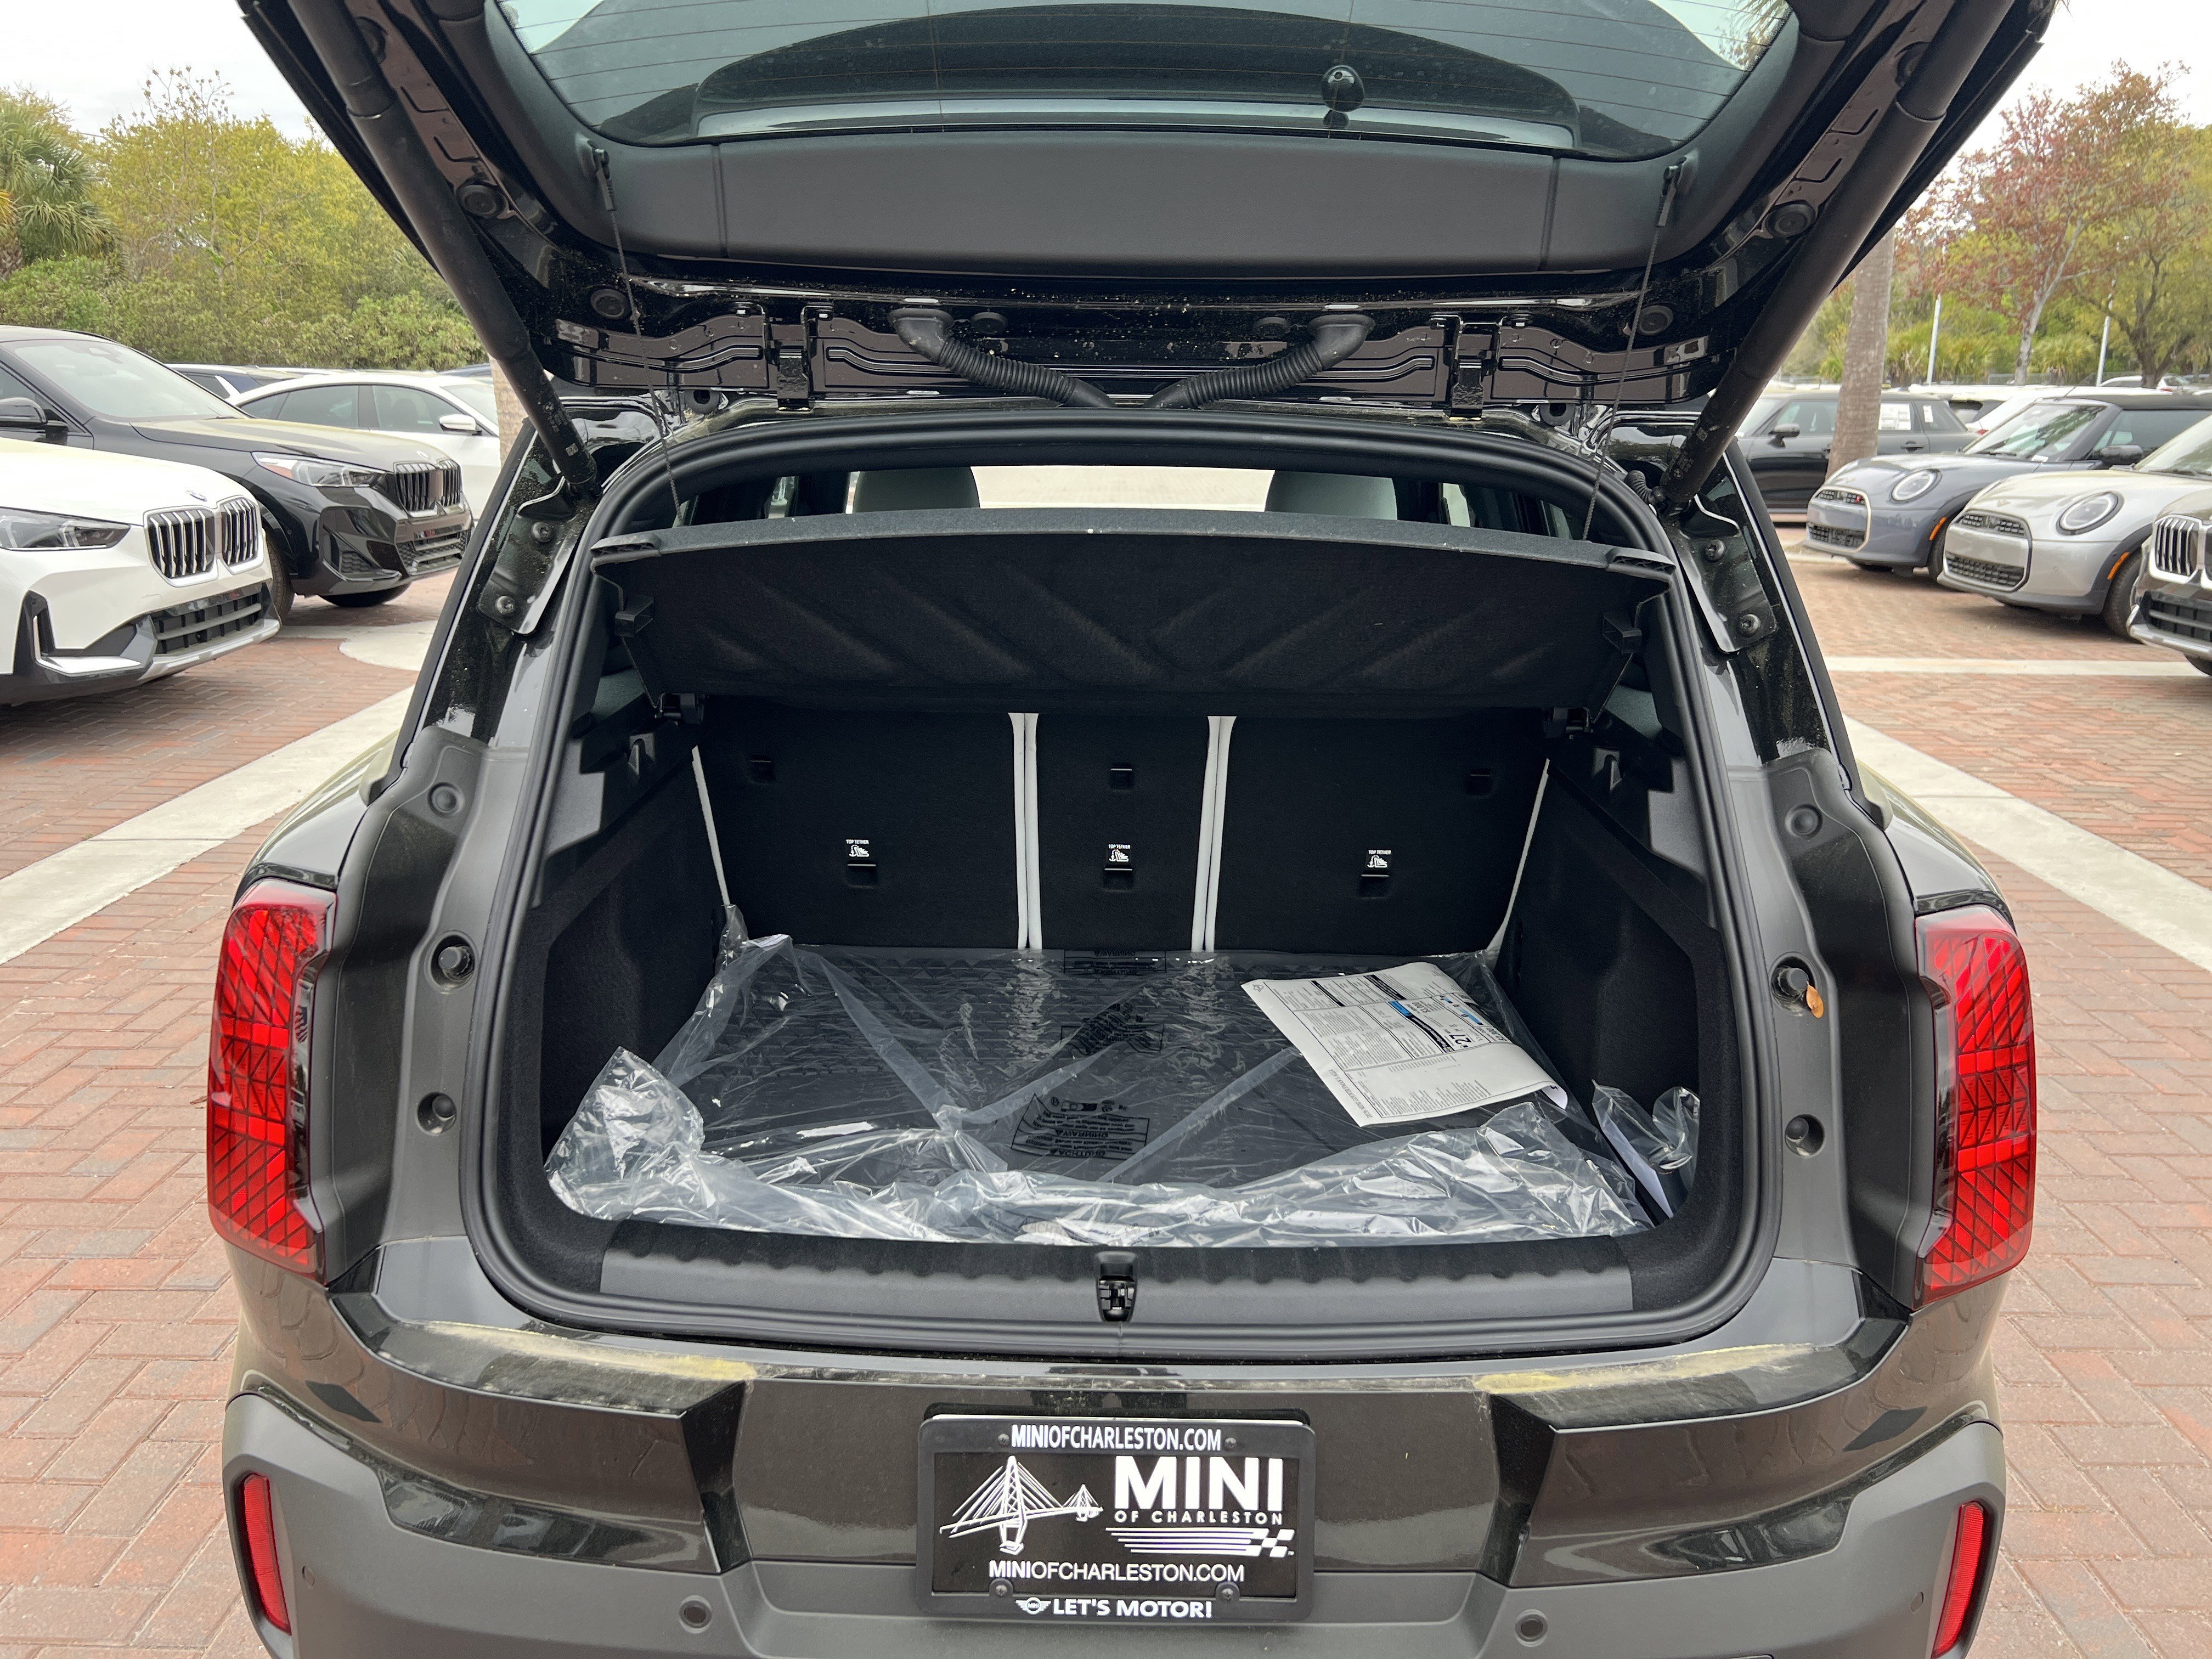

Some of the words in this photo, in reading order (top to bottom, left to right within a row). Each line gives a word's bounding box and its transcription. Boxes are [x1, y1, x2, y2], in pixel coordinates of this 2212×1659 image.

[1448, 1034, 1472, 1045] 27
[1012, 1424, 1222, 1452] MINIOFCHARLESTON.COM
[1114, 1455, 1284, 1511] MINI
[1114, 1510, 1139, 1524] OF
[1152, 1510, 1283, 1525] CHARLESTON
[989, 1560, 1245, 1582] MINIOFCHARLESTON.COM
[1053, 1598, 1110, 1617] LET'S
[1116, 1600, 1212, 1618] MOTOR!
